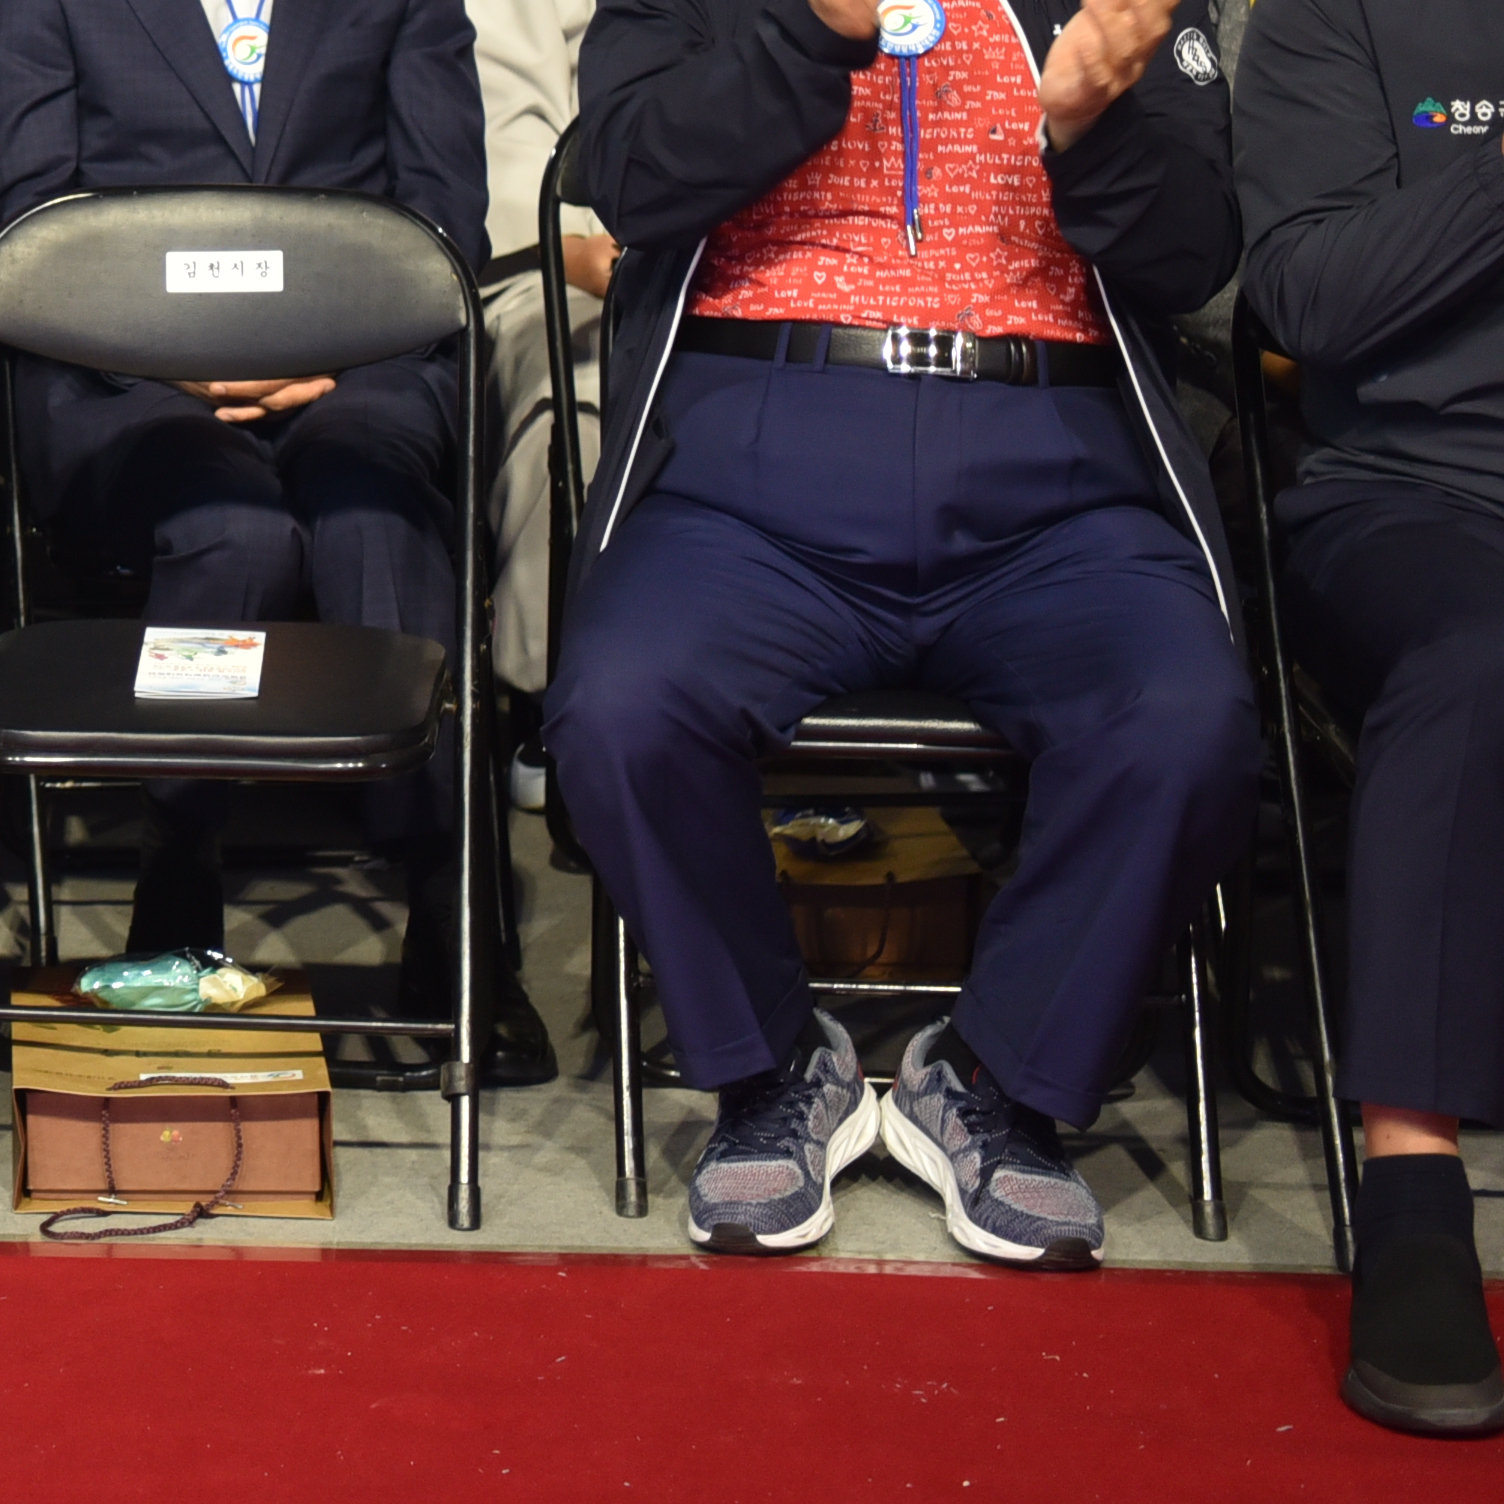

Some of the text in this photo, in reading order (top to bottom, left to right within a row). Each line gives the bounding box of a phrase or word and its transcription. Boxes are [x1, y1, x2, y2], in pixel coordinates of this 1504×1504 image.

[942, 0, 981, 9] MARINE
[955, 41, 968, 50] DE
[972, 42, 981, 50] X
[948, 71, 968, 80] JDX
[997, 74, 1022, 84] LOVE
[985, 90, 1006, 100] JDX
[928, 111, 968, 122] MARINE
[992, 107, 1016, 117] LOVE
[1005, 120, 1029, 131] LOVE
[842, 139, 870, 151] LOVE
[937, 144, 978, 154] MARINE
[975, 153, 1042, 166] MULTISPO
[828, 174, 904, 188] JOIE DE X LOV
[990, 172, 1021, 186] LOVE
[945, 184, 971, 194] LOVE
[939, 203, 952, 214] DE
[958, 225, 999, 236] MARINE
[817, 256, 838, 266] JDX
[843, 264, 869, 274] LOVE
[876, 268, 912, 277] MARINE
[774, 289, 798, 298] LOVE
[971, 293, 990, 303] JDX
[790, 299, 814, 308] LOVE
[850, 295, 940, 308] MULTISPORTS
[1014, 298, 1038, 309] LOVE
[861, 310, 920, 325] JDX LOVE
[1007, 314, 1026, 325] JDX
